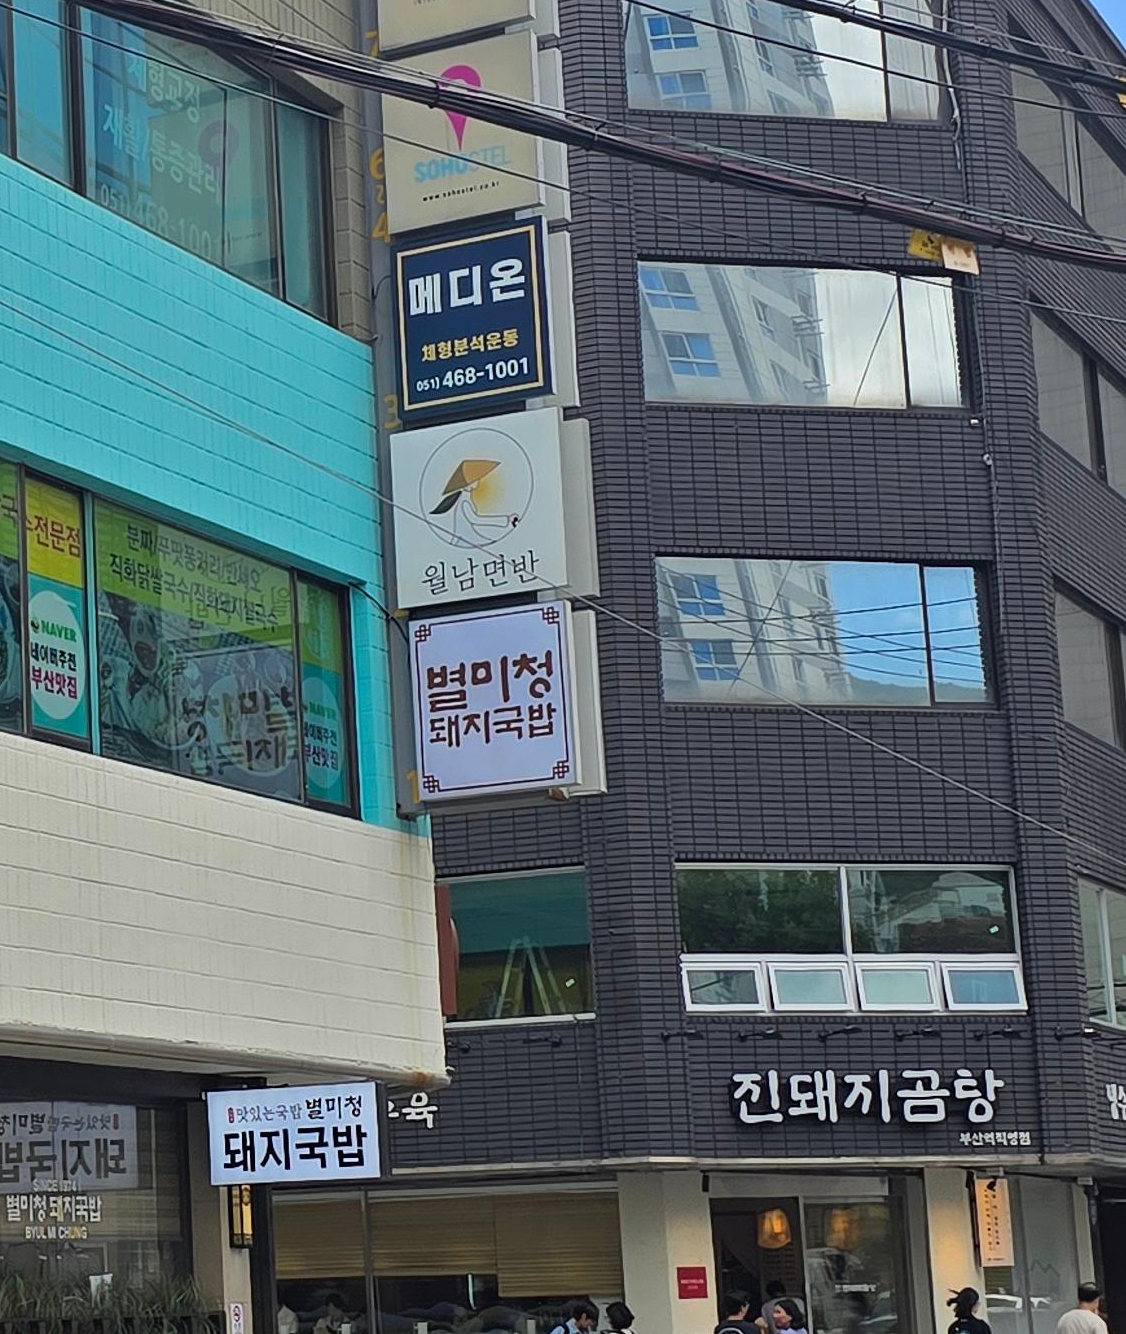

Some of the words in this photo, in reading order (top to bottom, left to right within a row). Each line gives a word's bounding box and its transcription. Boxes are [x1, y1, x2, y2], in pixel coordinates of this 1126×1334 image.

[413, 144, 511, 185] SOHOSTEL
[408, 258, 525, 316] 메디온
[421, 329, 520, 363] 체형분석운동
[416, 376, 441, 393] 051)
[443, 357, 529, 389] 468-1001
[421, 549, 540, 595] 월남면반
[41, 619, 77, 643] NAVER
[31, 665, 78, 700] 부산맛집
[426, 649, 554, 713] 별미청
[429, 702, 557, 748] 돼지국밥
[236, 1103, 302, 1124] 맛있는국밥
[305, 1095, 363, 1120] 별미청
[731, 1068, 1005, 1124] 진돼지곰탕
[224, 1124, 367, 1172] 돼지국밥
[959, 1131, 1032, 1146] 부산역직영점
[6, 1194, 47, 1222] 별미청
[49, 1194, 102, 1222] 돼지국밥
[25, 1226, 47, 1239] BYUL
[58, 1226, 87, 1239] CHUNG
